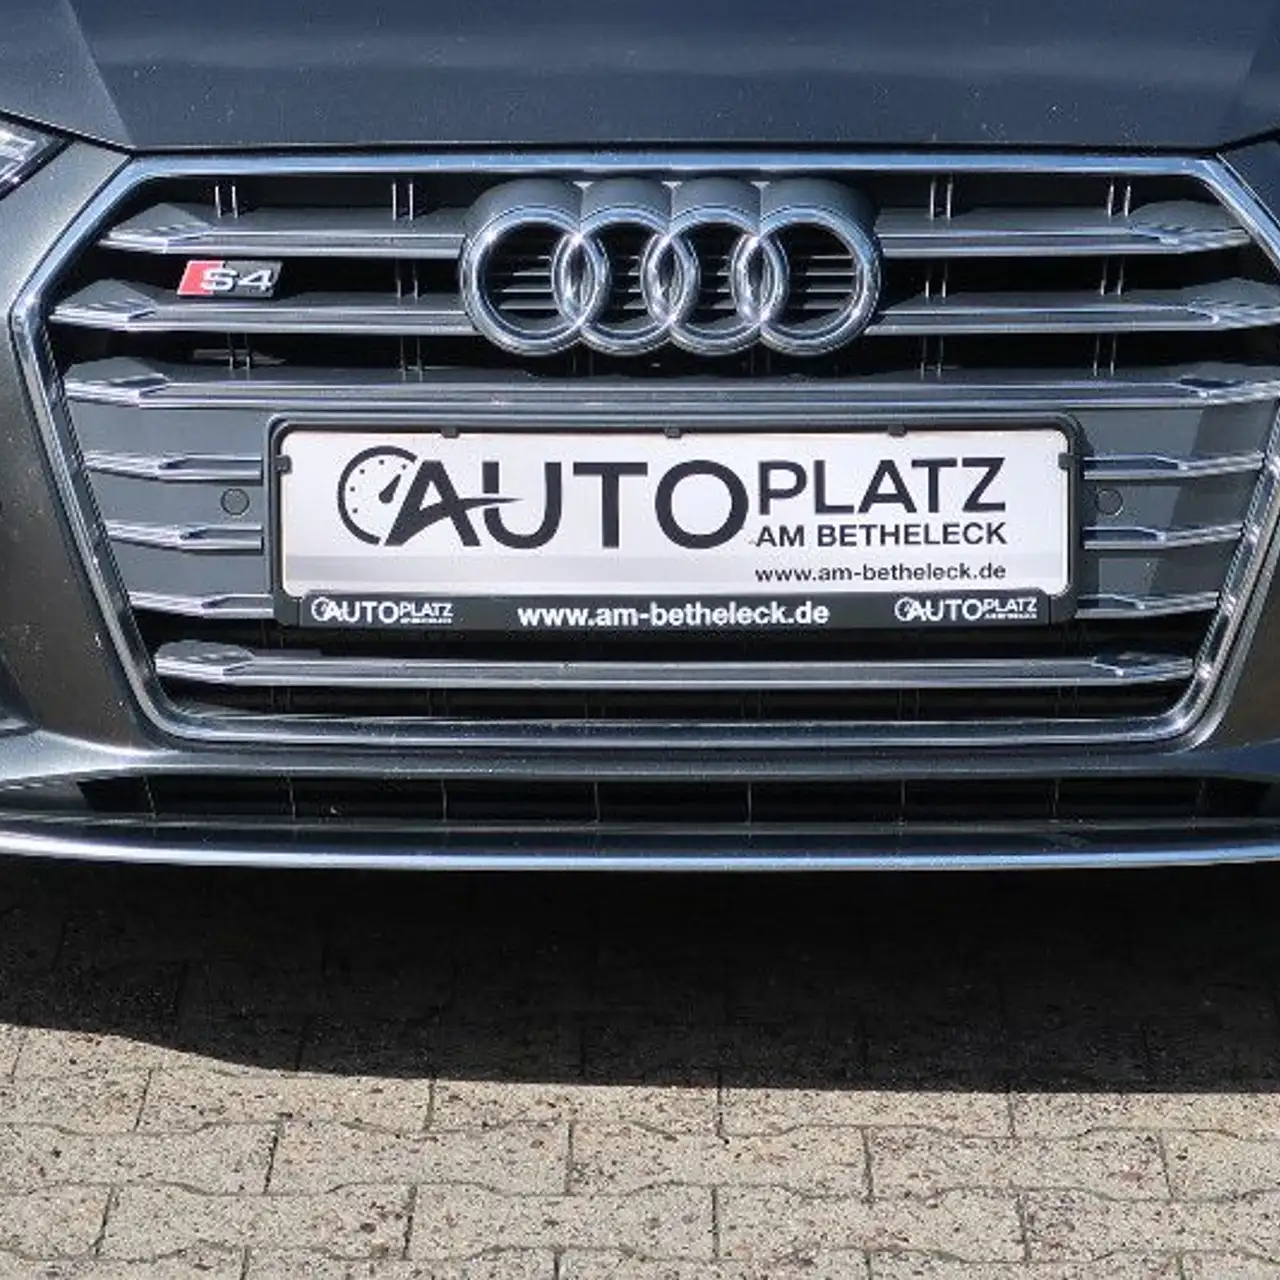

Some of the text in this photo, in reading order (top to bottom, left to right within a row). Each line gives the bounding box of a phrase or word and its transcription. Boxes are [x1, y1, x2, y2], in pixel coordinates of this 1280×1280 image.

[200, 269, 272, 291] S4
[756, 522, 1007, 547] AM BETHELECK
[755, 562, 1006, 582] www.am-betheleck.de
[517, 601, 830, 627] www.am-betheleck.de
